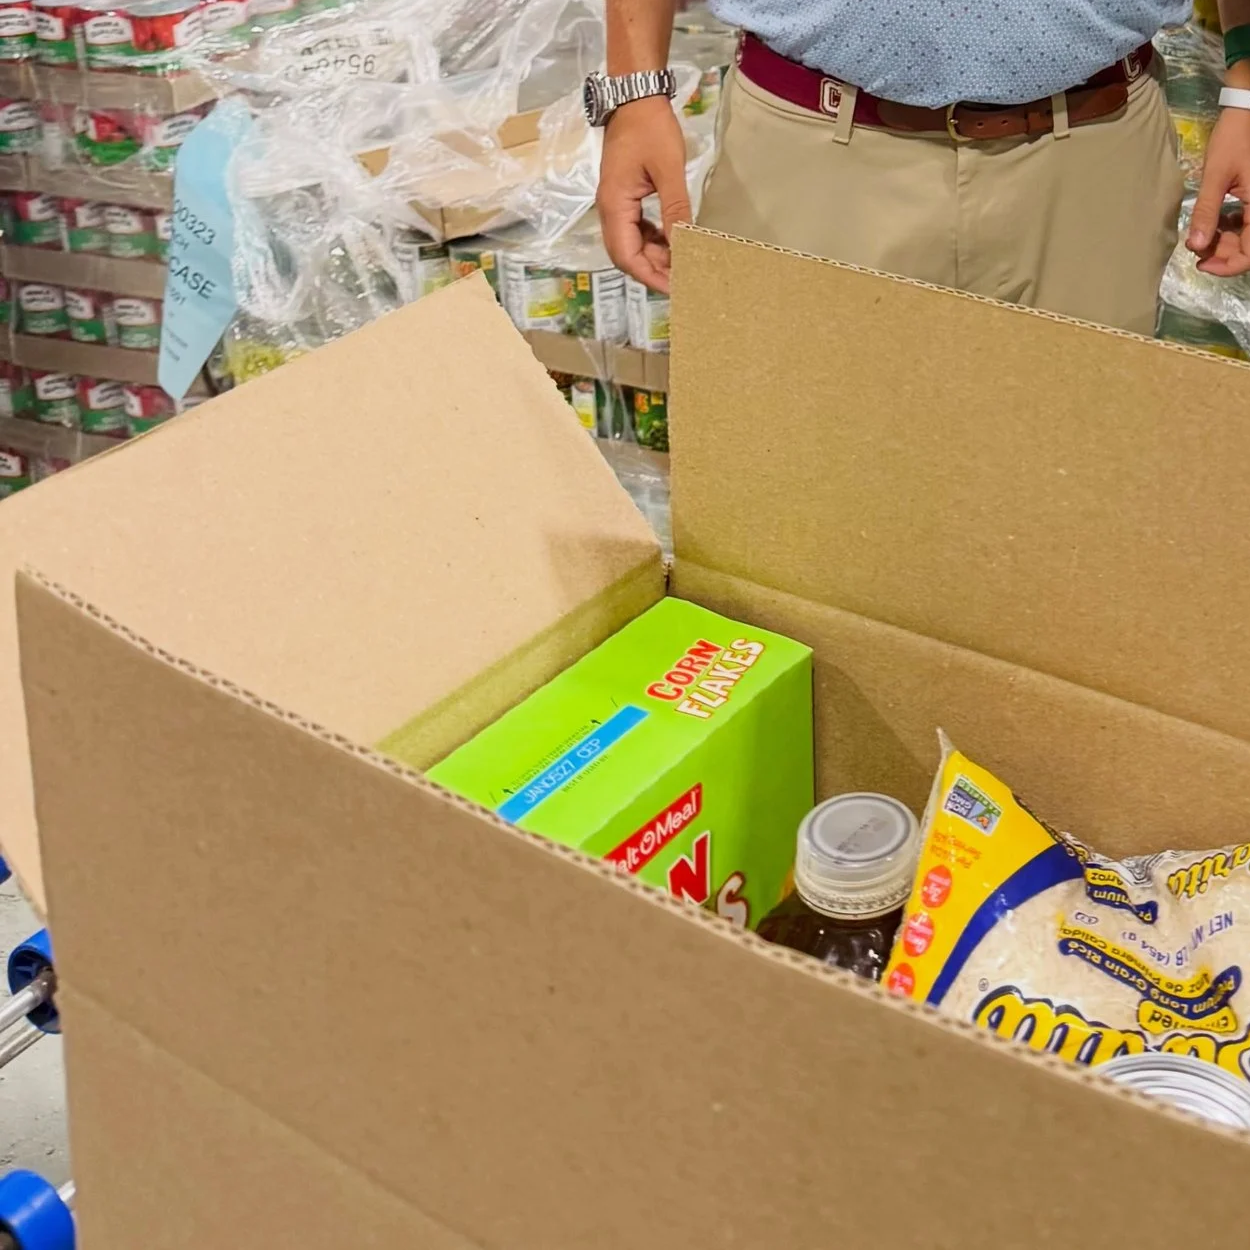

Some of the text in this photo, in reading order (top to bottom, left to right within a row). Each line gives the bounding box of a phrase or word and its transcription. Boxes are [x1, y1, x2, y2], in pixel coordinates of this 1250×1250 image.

[168, 256, 217, 300] CASE
[646, 638, 724, 702] CORN
[675, 637, 766, 719] FLAKES
[950, 792, 972, 809] GMO
[1091, 871, 1124, 886] Arroz
[1208, 911, 1234, 937] NET
[1104, 960, 1149, 991] Grain
[1150, 990, 1189, 1014] Long
[1165, 980, 1184, 994] de
